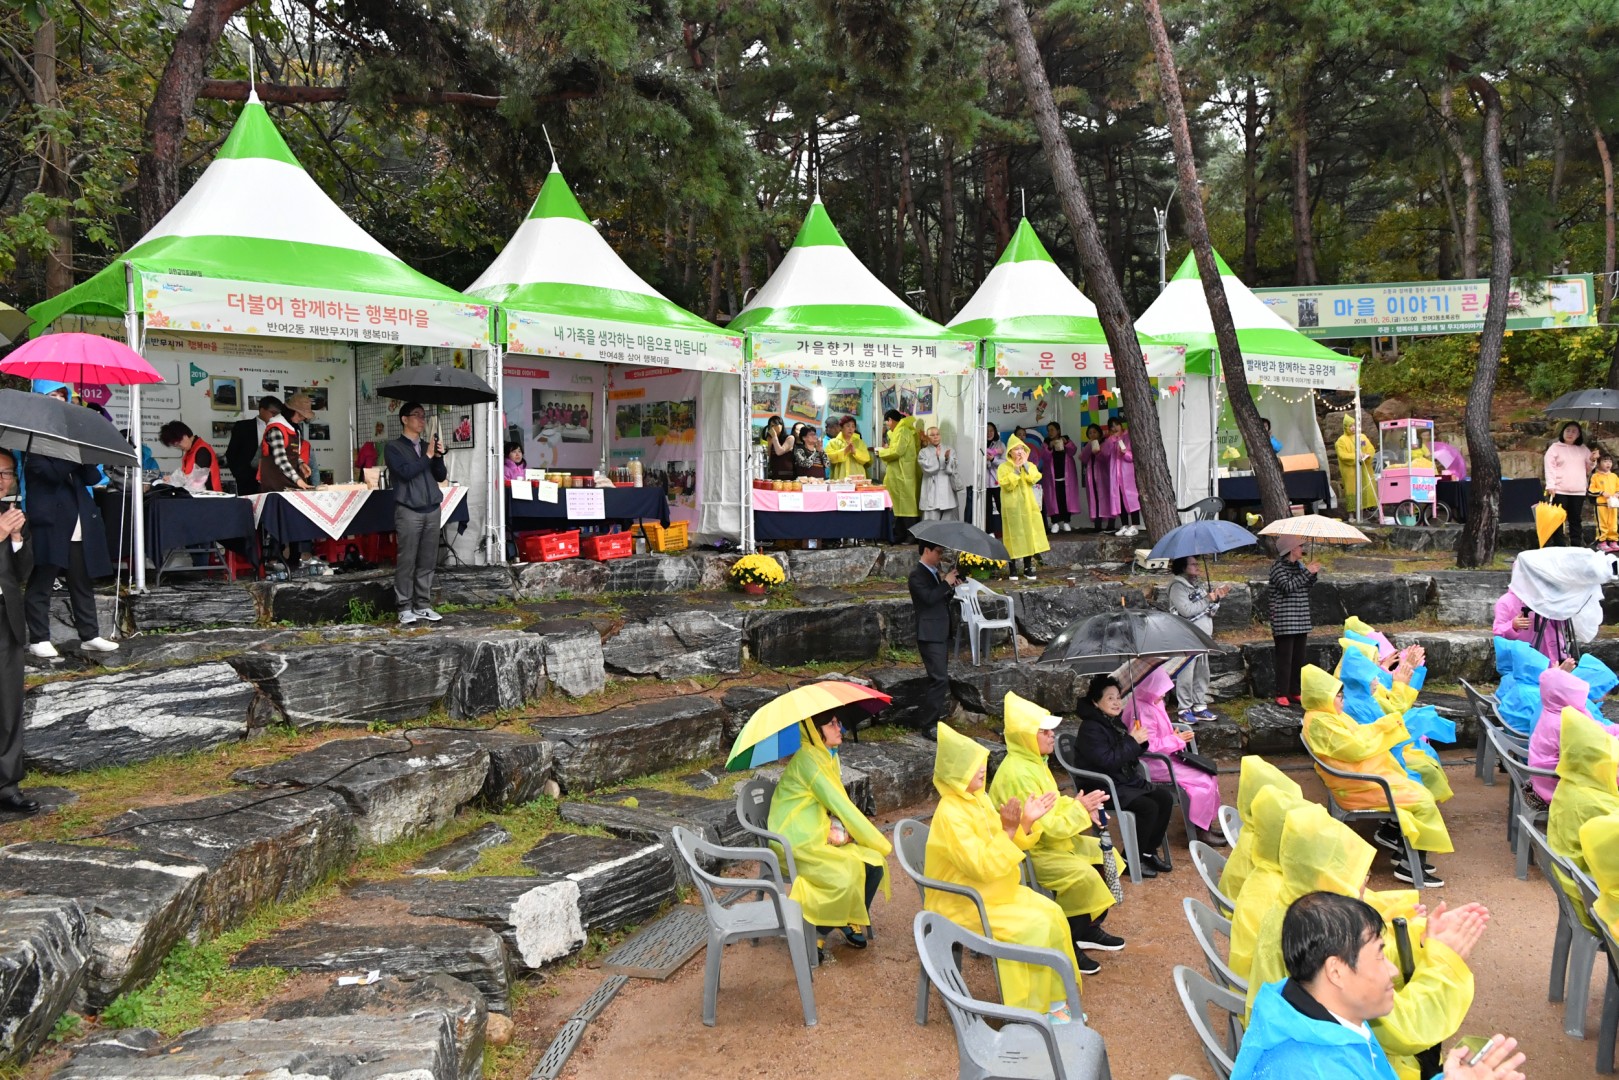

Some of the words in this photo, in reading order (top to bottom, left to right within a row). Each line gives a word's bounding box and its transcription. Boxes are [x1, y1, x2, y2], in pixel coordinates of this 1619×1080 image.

[227, 293, 284, 315] 더불어
[290, 298, 361, 323] 함께하는
[365, 304, 430, 329] 행복마을
[1334, 297, 1375, 316] 마을
[1387, 294, 1449, 314] 이야기
[267, 322, 306, 336] 반여2동
[309, 325, 359, 338] 재반무지개
[362, 328, 400, 341] 행복마을
[1396, 325, 1419, 333] 행복마을
[1421, 324, 1438, 332] 공동체
[1447, 322, 1485, 331] 무지개이야기
[554, 326, 564, 341] 내
[567, 327, 596, 346] 가족을
[599, 330, 635, 349] 생각하는
[638, 334, 673, 352] 마음으로
[675, 338, 708, 356] 만듭니다
[797, 341, 854, 356] 가을향기
[863, 343, 904, 359] 뿜내는
[911, 345, 937, 359] 카페
[599, 351, 625, 361] 반여4동
[627, 353, 641, 362] 삼어
[643, 354, 670, 365] 행복마을
[831, 359, 855, 368] 반송1동
[858, 359, 877, 368] 장산길
[879, 360, 905, 369] 행복마을
[1246, 359, 1276, 373] 빨래방과
[1278, 361, 1307, 375] 함께하는
[1308, 363, 1336, 376] 공유경제
